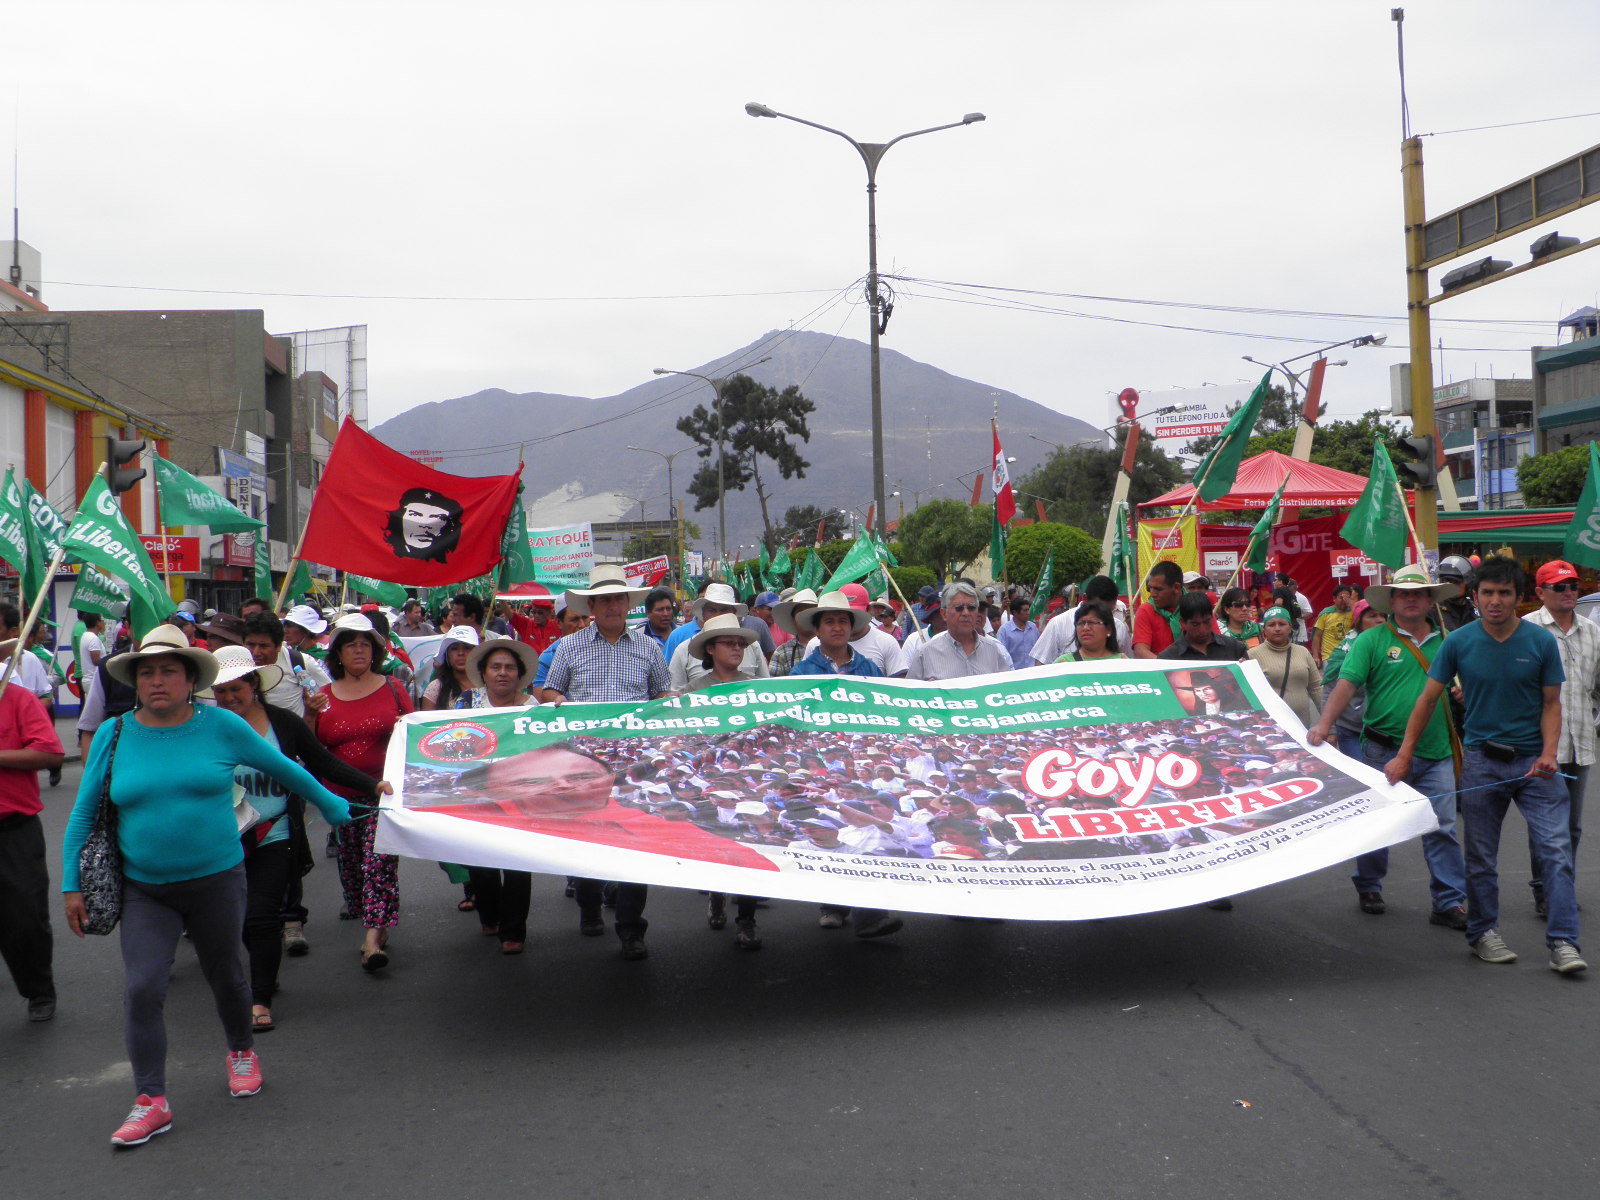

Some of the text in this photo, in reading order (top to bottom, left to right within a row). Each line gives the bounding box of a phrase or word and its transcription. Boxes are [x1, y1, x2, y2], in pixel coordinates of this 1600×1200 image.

[1185, 403, 1207, 412] AMBIA
[1204, 412, 1219, 420] FIJO
[1157, 429, 1170, 437] SIN
[1171, 427, 1201, 436] PERDER
[1203, 425, 1213, 433] TU
[1244, 498, 1265, 507] Feria
[1336, 498, 1346, 506] de
[528, 530, 589, 547] BAYEQUE
[533, 554, 567, 563] REGORIO
[1209, 557, 1230, 566] Claro
[1337, 554, 1366, 566] Claro
[689, 688, 823, 708] Regional
[830, 688, 866, 703] de
[870, 691, 979, 710] Rondas
[985, 682, 1162, 707] Campesinas,
[728, 714, 746, 726] e
[753, 704, 901, 726] Indígenas
[908, 714, 944, 728] de
[951, 706, 1107, 729] Cajamarca
[1023, 750, 1201, 807] Goyo
[1010, 779, 1321, 841] LIBERTAD
[828, 855, 846, 863] la
[850, 857, 921, 870] defensa
[926, 862, 948, 873] de
[952, 863, 979, 873] los
[982, 864, 1076, 875] territorios,
[1079, 862, 1097, 872] el
[1100, 860, 1147, 870] agua,
[1148, 857, 1167, 866] la
[1235, 827, 1287, 847] medio
[1290, 798, 1371, 829] ambiente,
[796, 861, 816, 872] la
[819, 864, 932, 884] democracia,
[936, 874, 954, 884] la
[957, 874, 1118, 887] descentralización,
[1119, 873, 1139, 882] la
[1140, 862, 1205, 881] justicia
[1207, 844, 1259, 867] social
[1259, 840, 1271, 851] y
[1275, 833, 1292, 845] la
